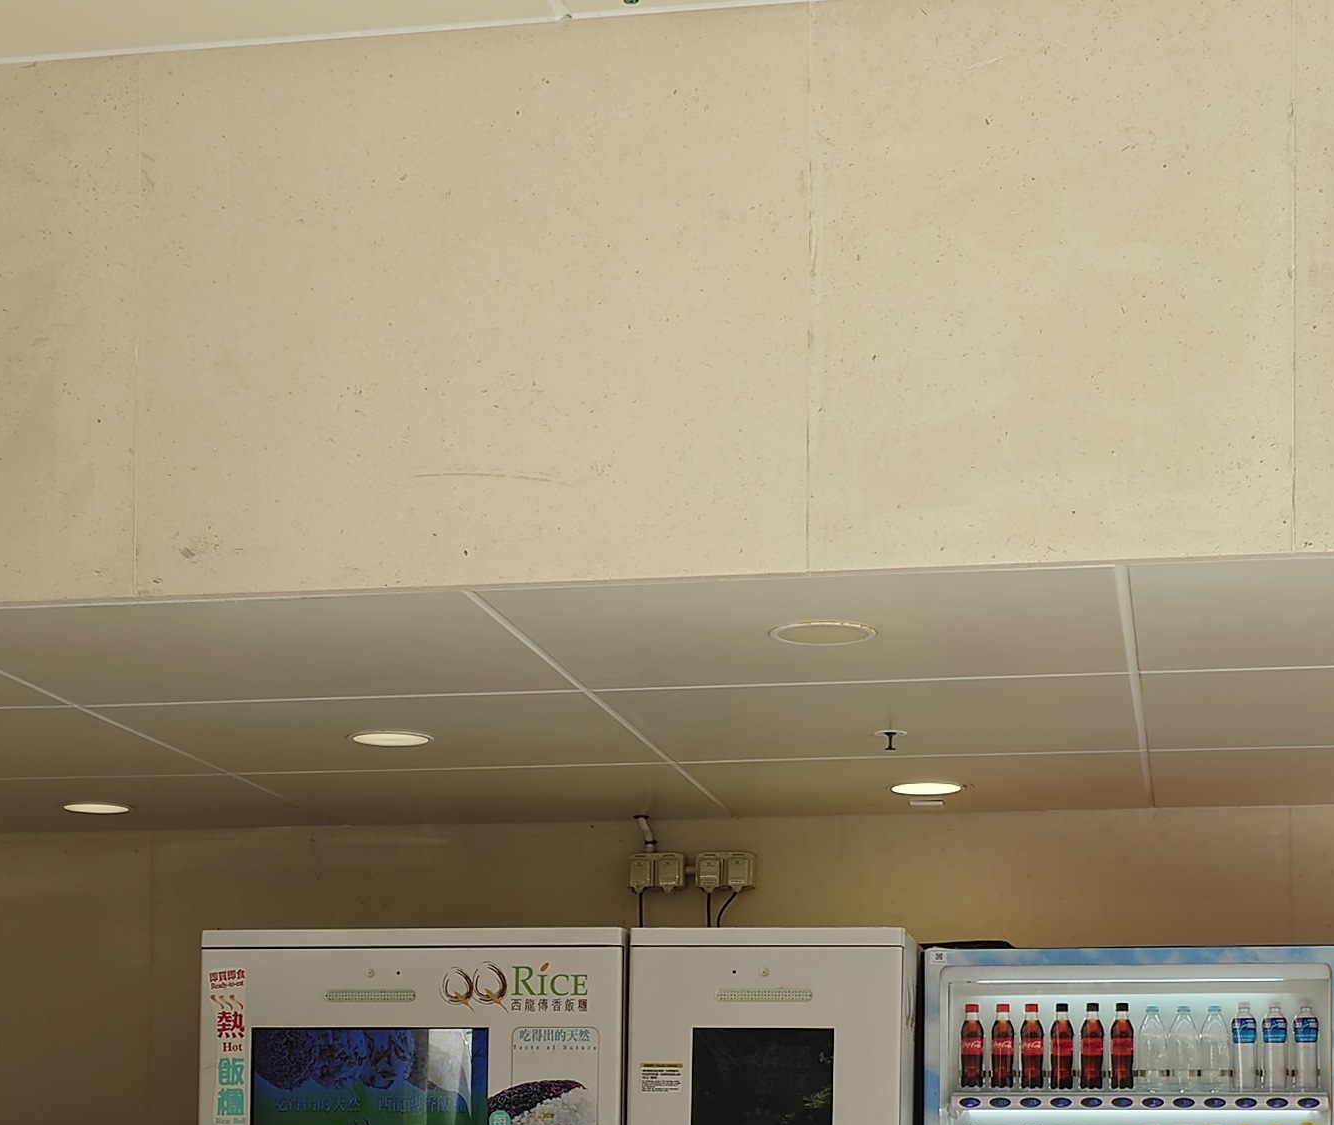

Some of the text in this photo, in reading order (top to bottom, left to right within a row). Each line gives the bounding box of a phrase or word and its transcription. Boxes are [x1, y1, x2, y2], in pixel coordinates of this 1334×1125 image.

[209, 969, 245, 982] 即買即食
[218, 1011, 245, 1038] 熱
[519, 1029, 590, 1042] 吃得出的天然
[223, 1042, 243, 1052] Hot
[218, 1058, 245, 1116] 飯糰
